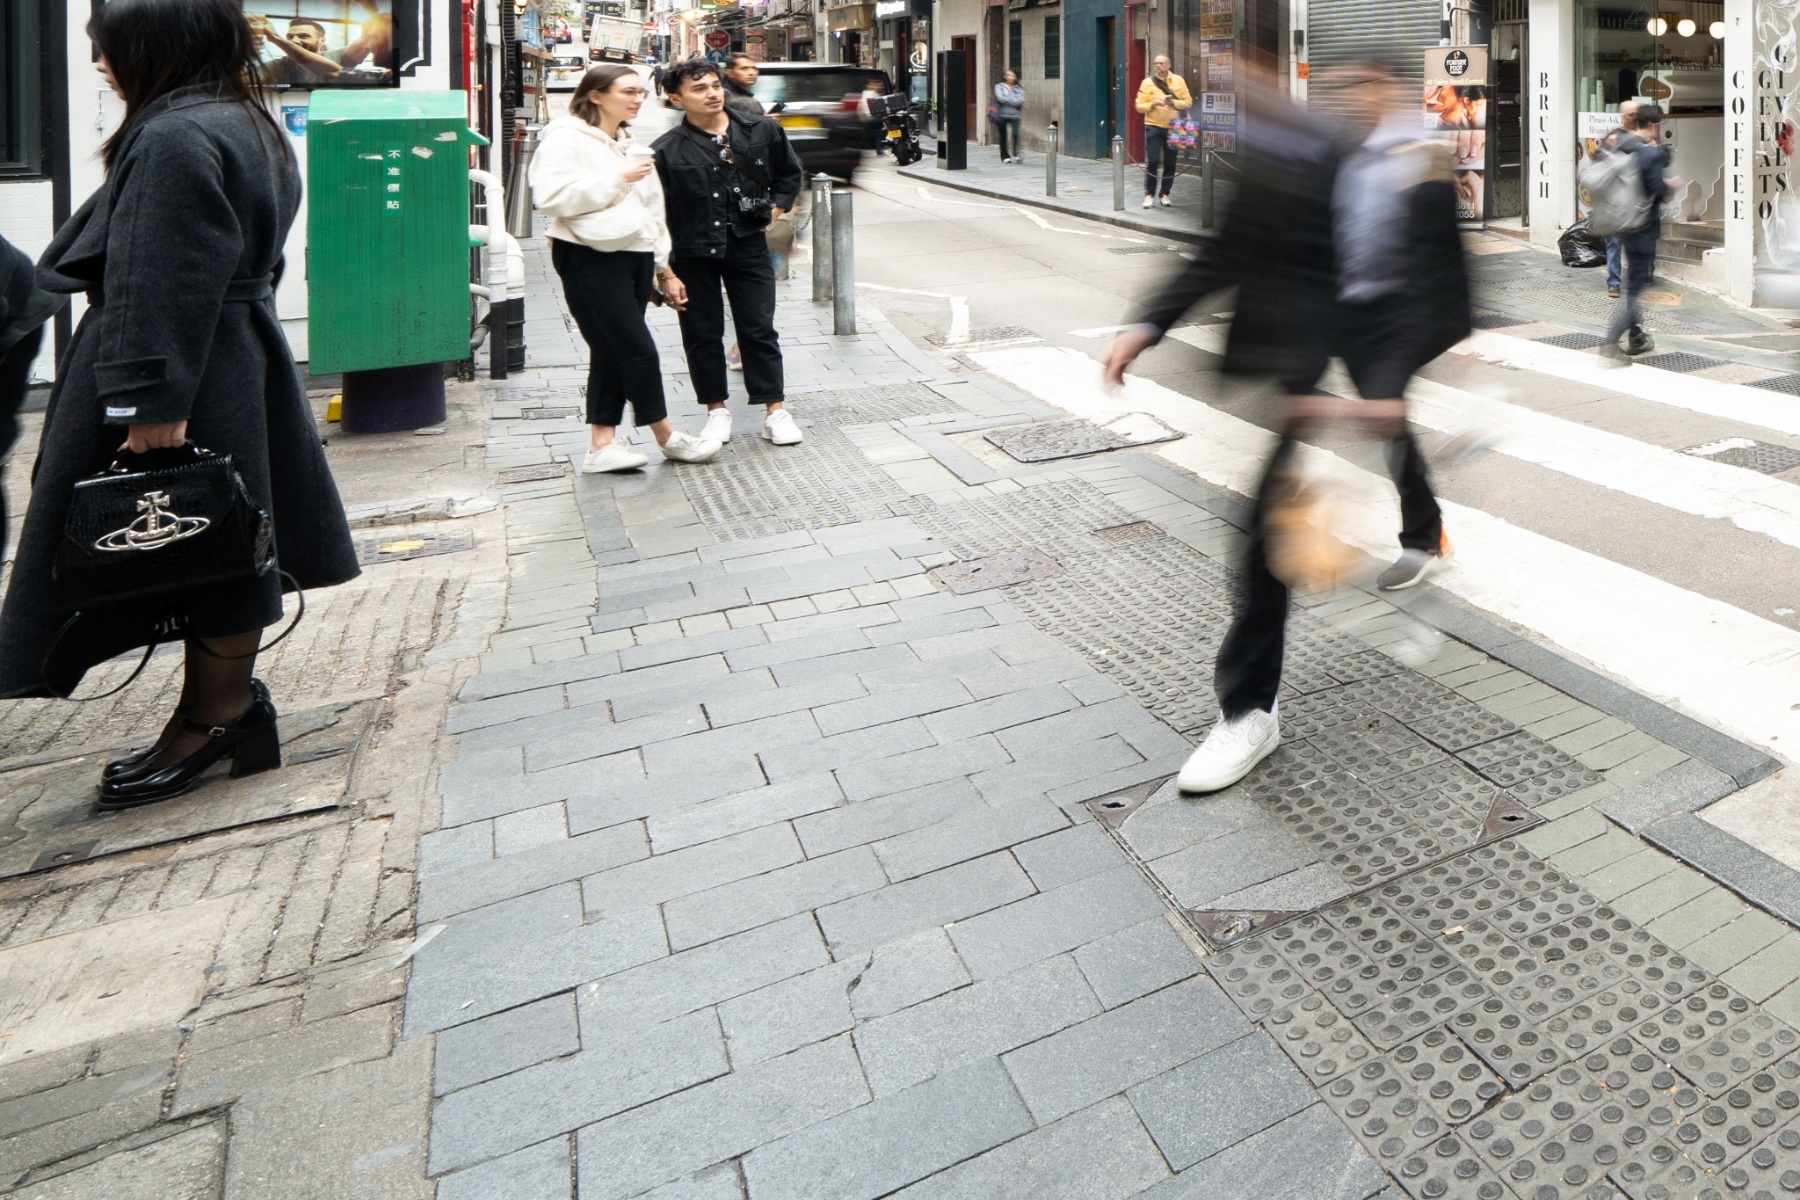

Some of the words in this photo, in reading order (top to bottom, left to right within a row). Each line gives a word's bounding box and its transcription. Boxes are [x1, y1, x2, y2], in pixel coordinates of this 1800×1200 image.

[1735, 17, 1740, 26] 7
[1539, 72, 1549, 199] BRUNCH
[1589, 115, 1606, 123] Please
[1732, 70, 1745, 220] COFFEE
[1758, 70, 1772, 220] GELATO
[387, 150, 400, 209] 不准標貼
